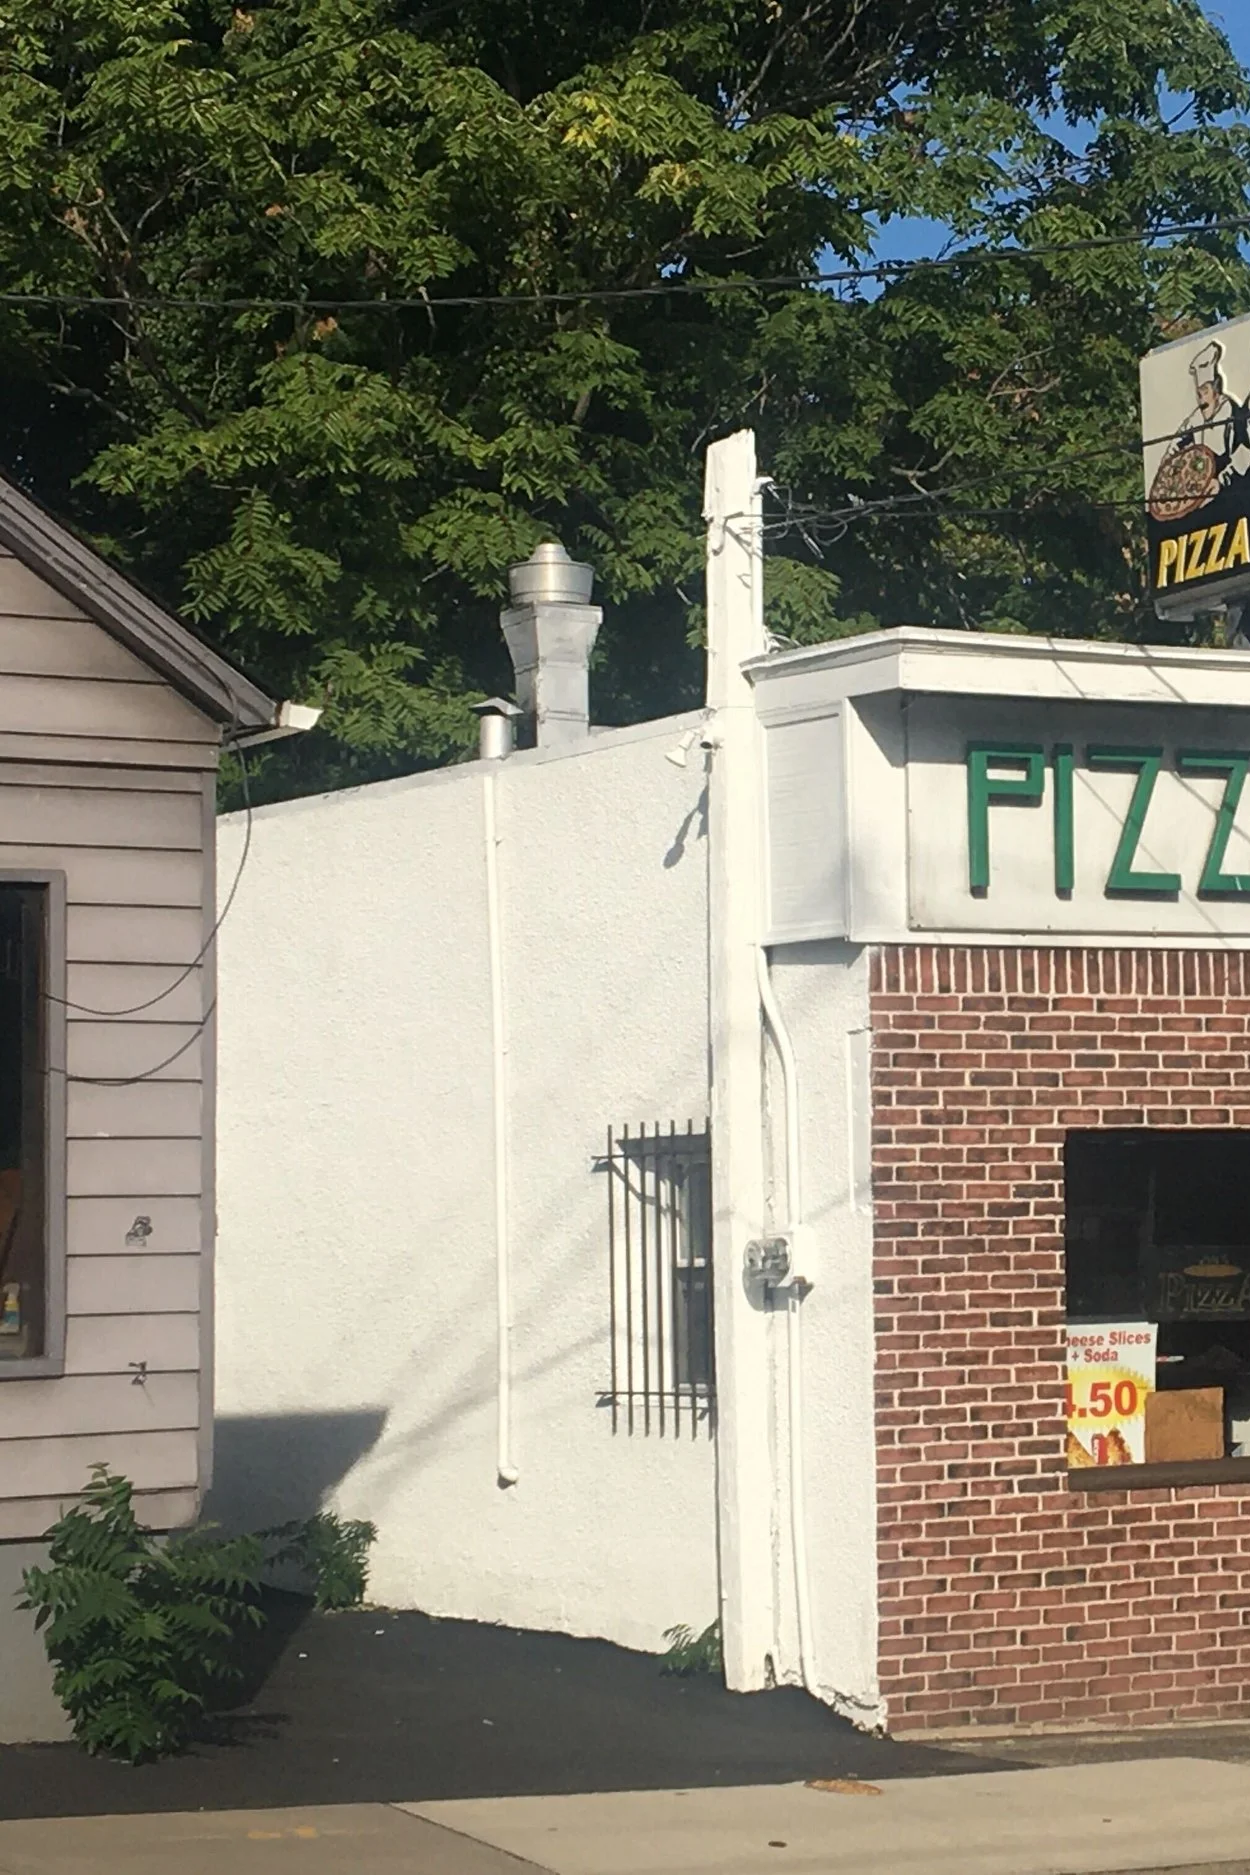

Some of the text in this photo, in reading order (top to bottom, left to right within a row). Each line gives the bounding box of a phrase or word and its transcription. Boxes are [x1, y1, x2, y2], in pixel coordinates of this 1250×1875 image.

[1066, 1330, 1151, 1347] heese Slices
[1084, 1347, 1119, 1363] Soda
